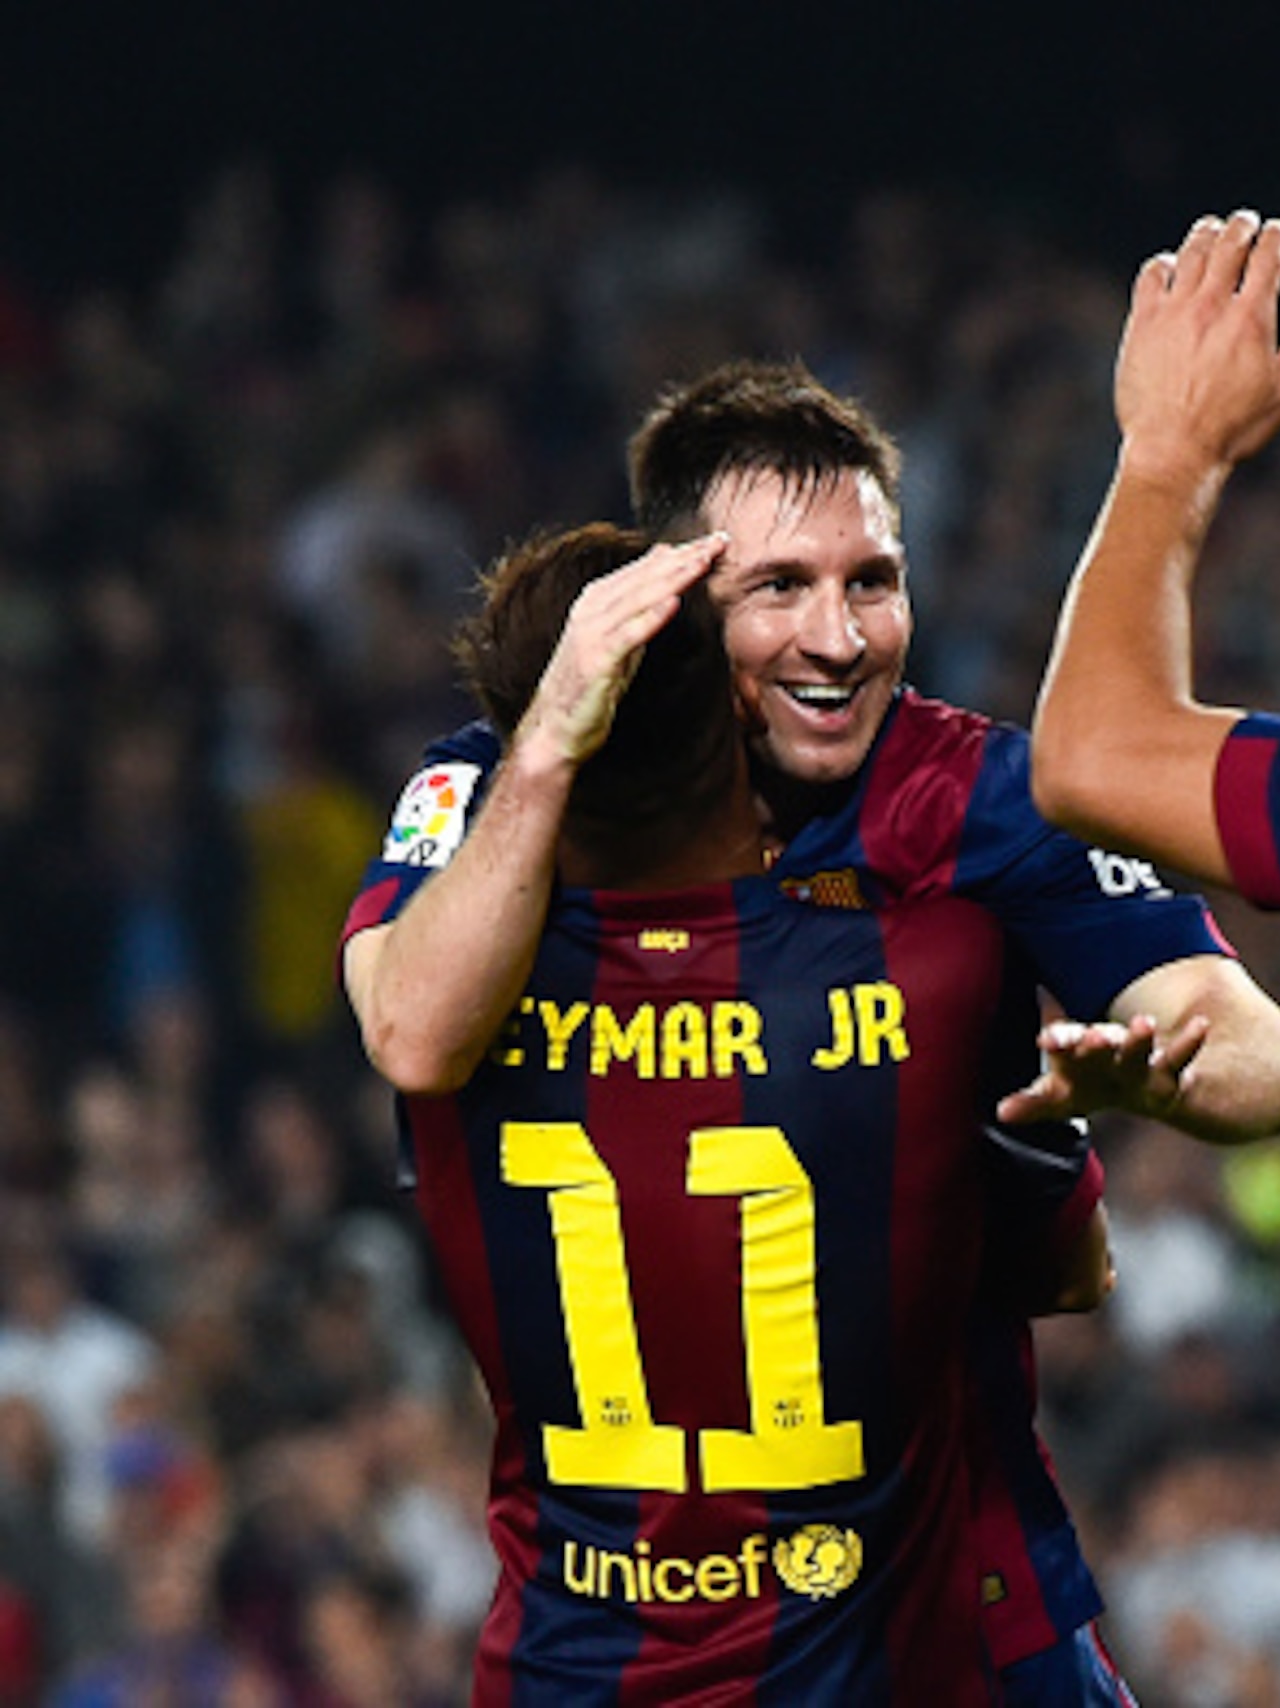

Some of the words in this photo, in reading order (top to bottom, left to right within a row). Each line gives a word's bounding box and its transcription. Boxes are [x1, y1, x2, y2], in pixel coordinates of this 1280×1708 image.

[812, 981, 911, 1070] JR
[499, 1120, 867, 1494] 11
[563, 1534, 769, 1603] unicef
